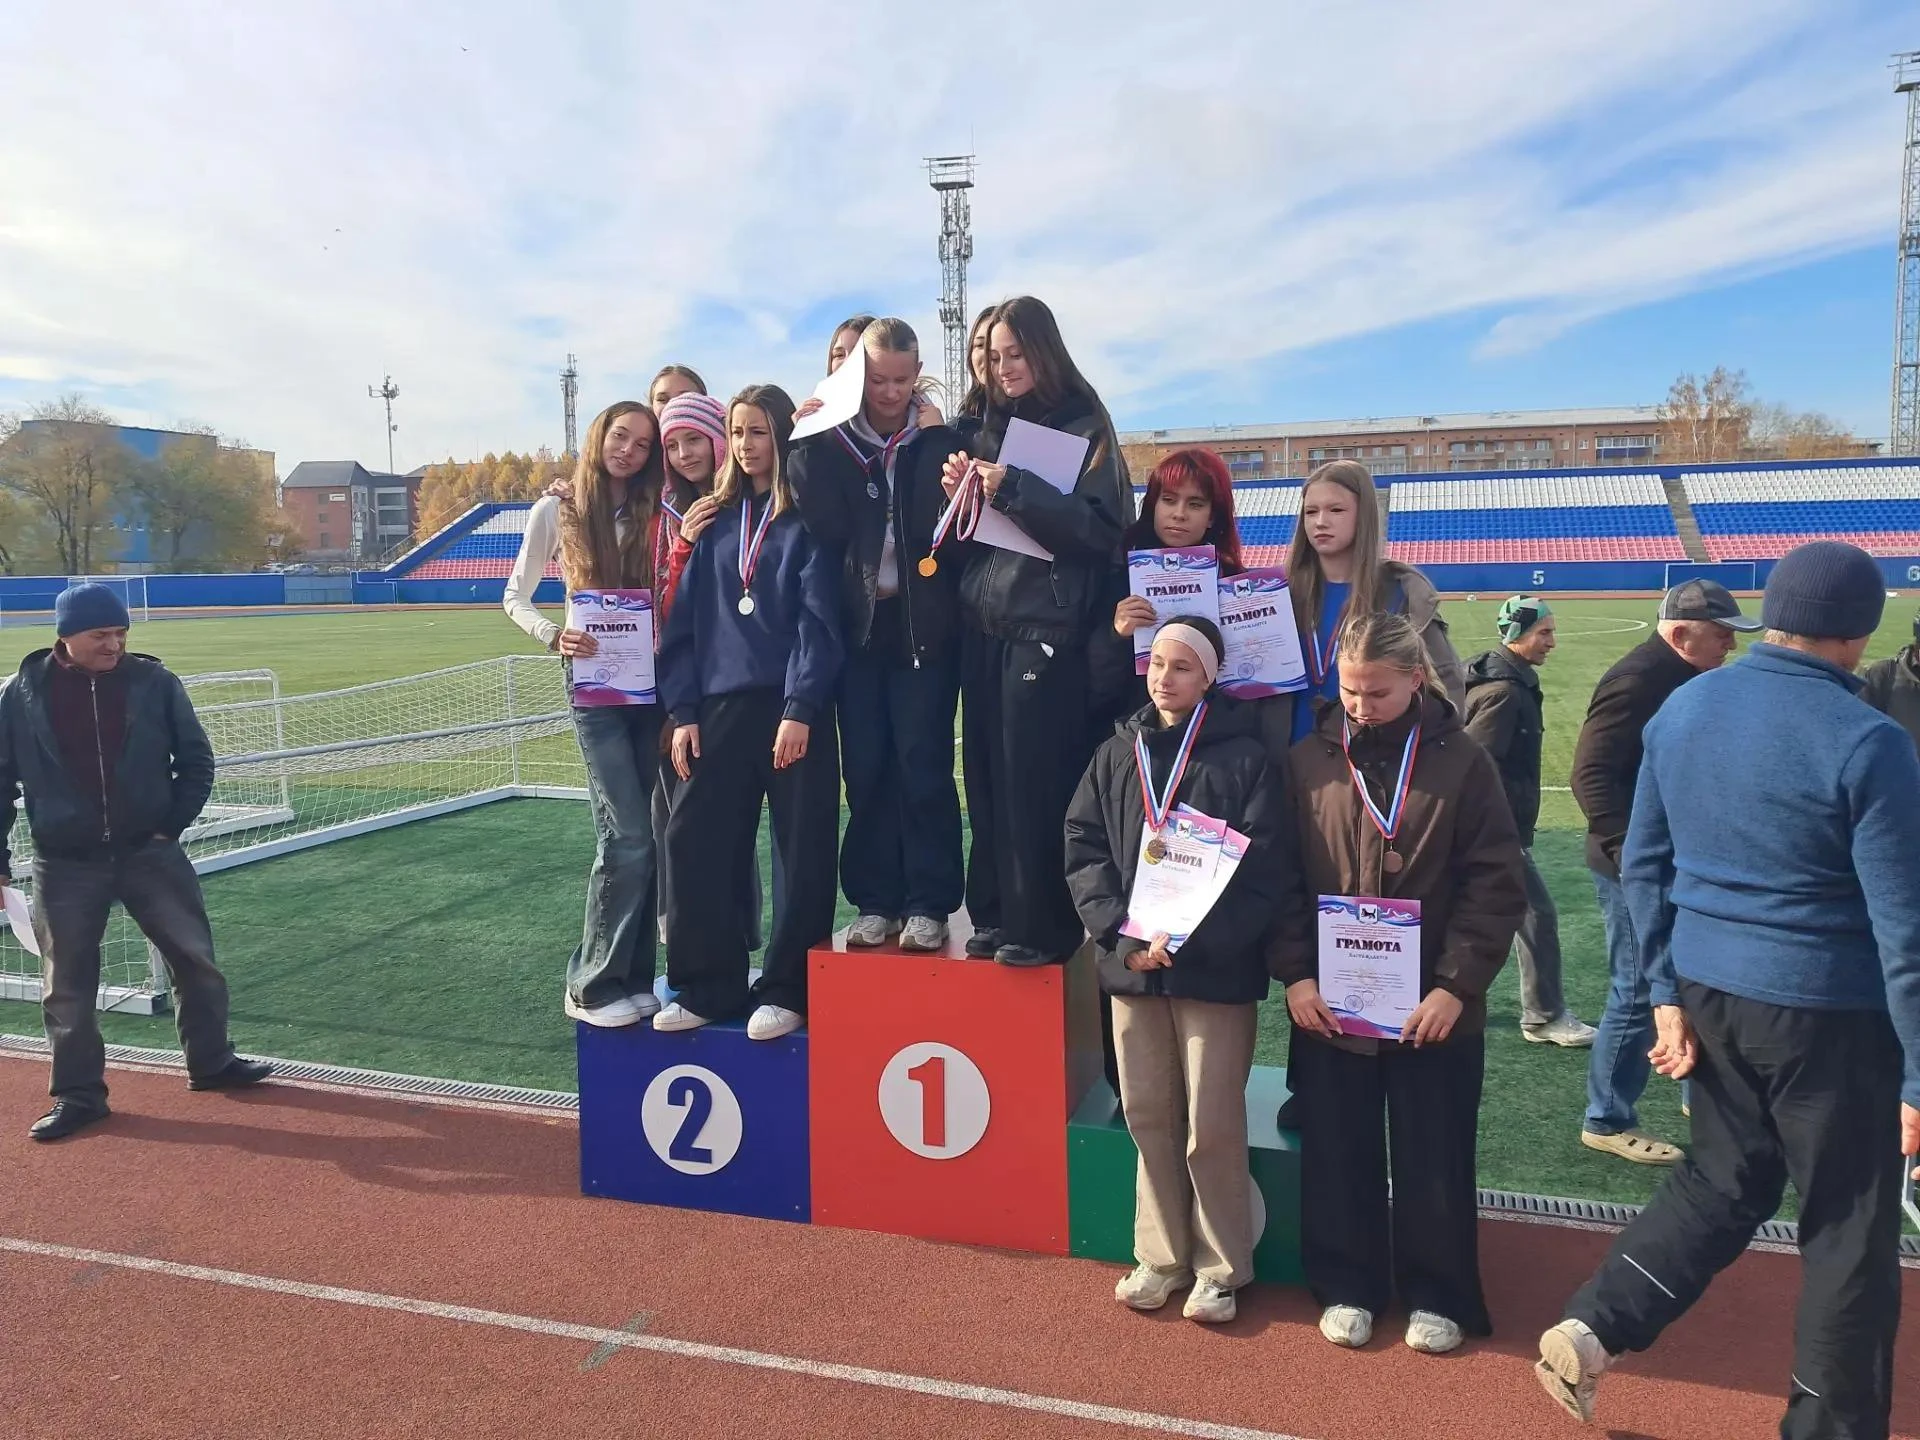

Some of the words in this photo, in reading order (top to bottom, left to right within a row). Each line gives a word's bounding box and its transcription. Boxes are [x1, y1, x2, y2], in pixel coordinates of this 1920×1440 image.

[1532, 570, 1545, 585] 5
[1145, 583, 1203, 597] ГРАМОТА
[1219, 605, 1278, 626] ГРАМОТА
[585, 623, 638, 632] ГРАМОТА
[1165, 850, 1203, 868] АМОТА
[1335, 937, 1402, 953] ГРАМОТА
[907, 1056, 946, 1148] 1
[667, 1076, 713, 1164] 2
